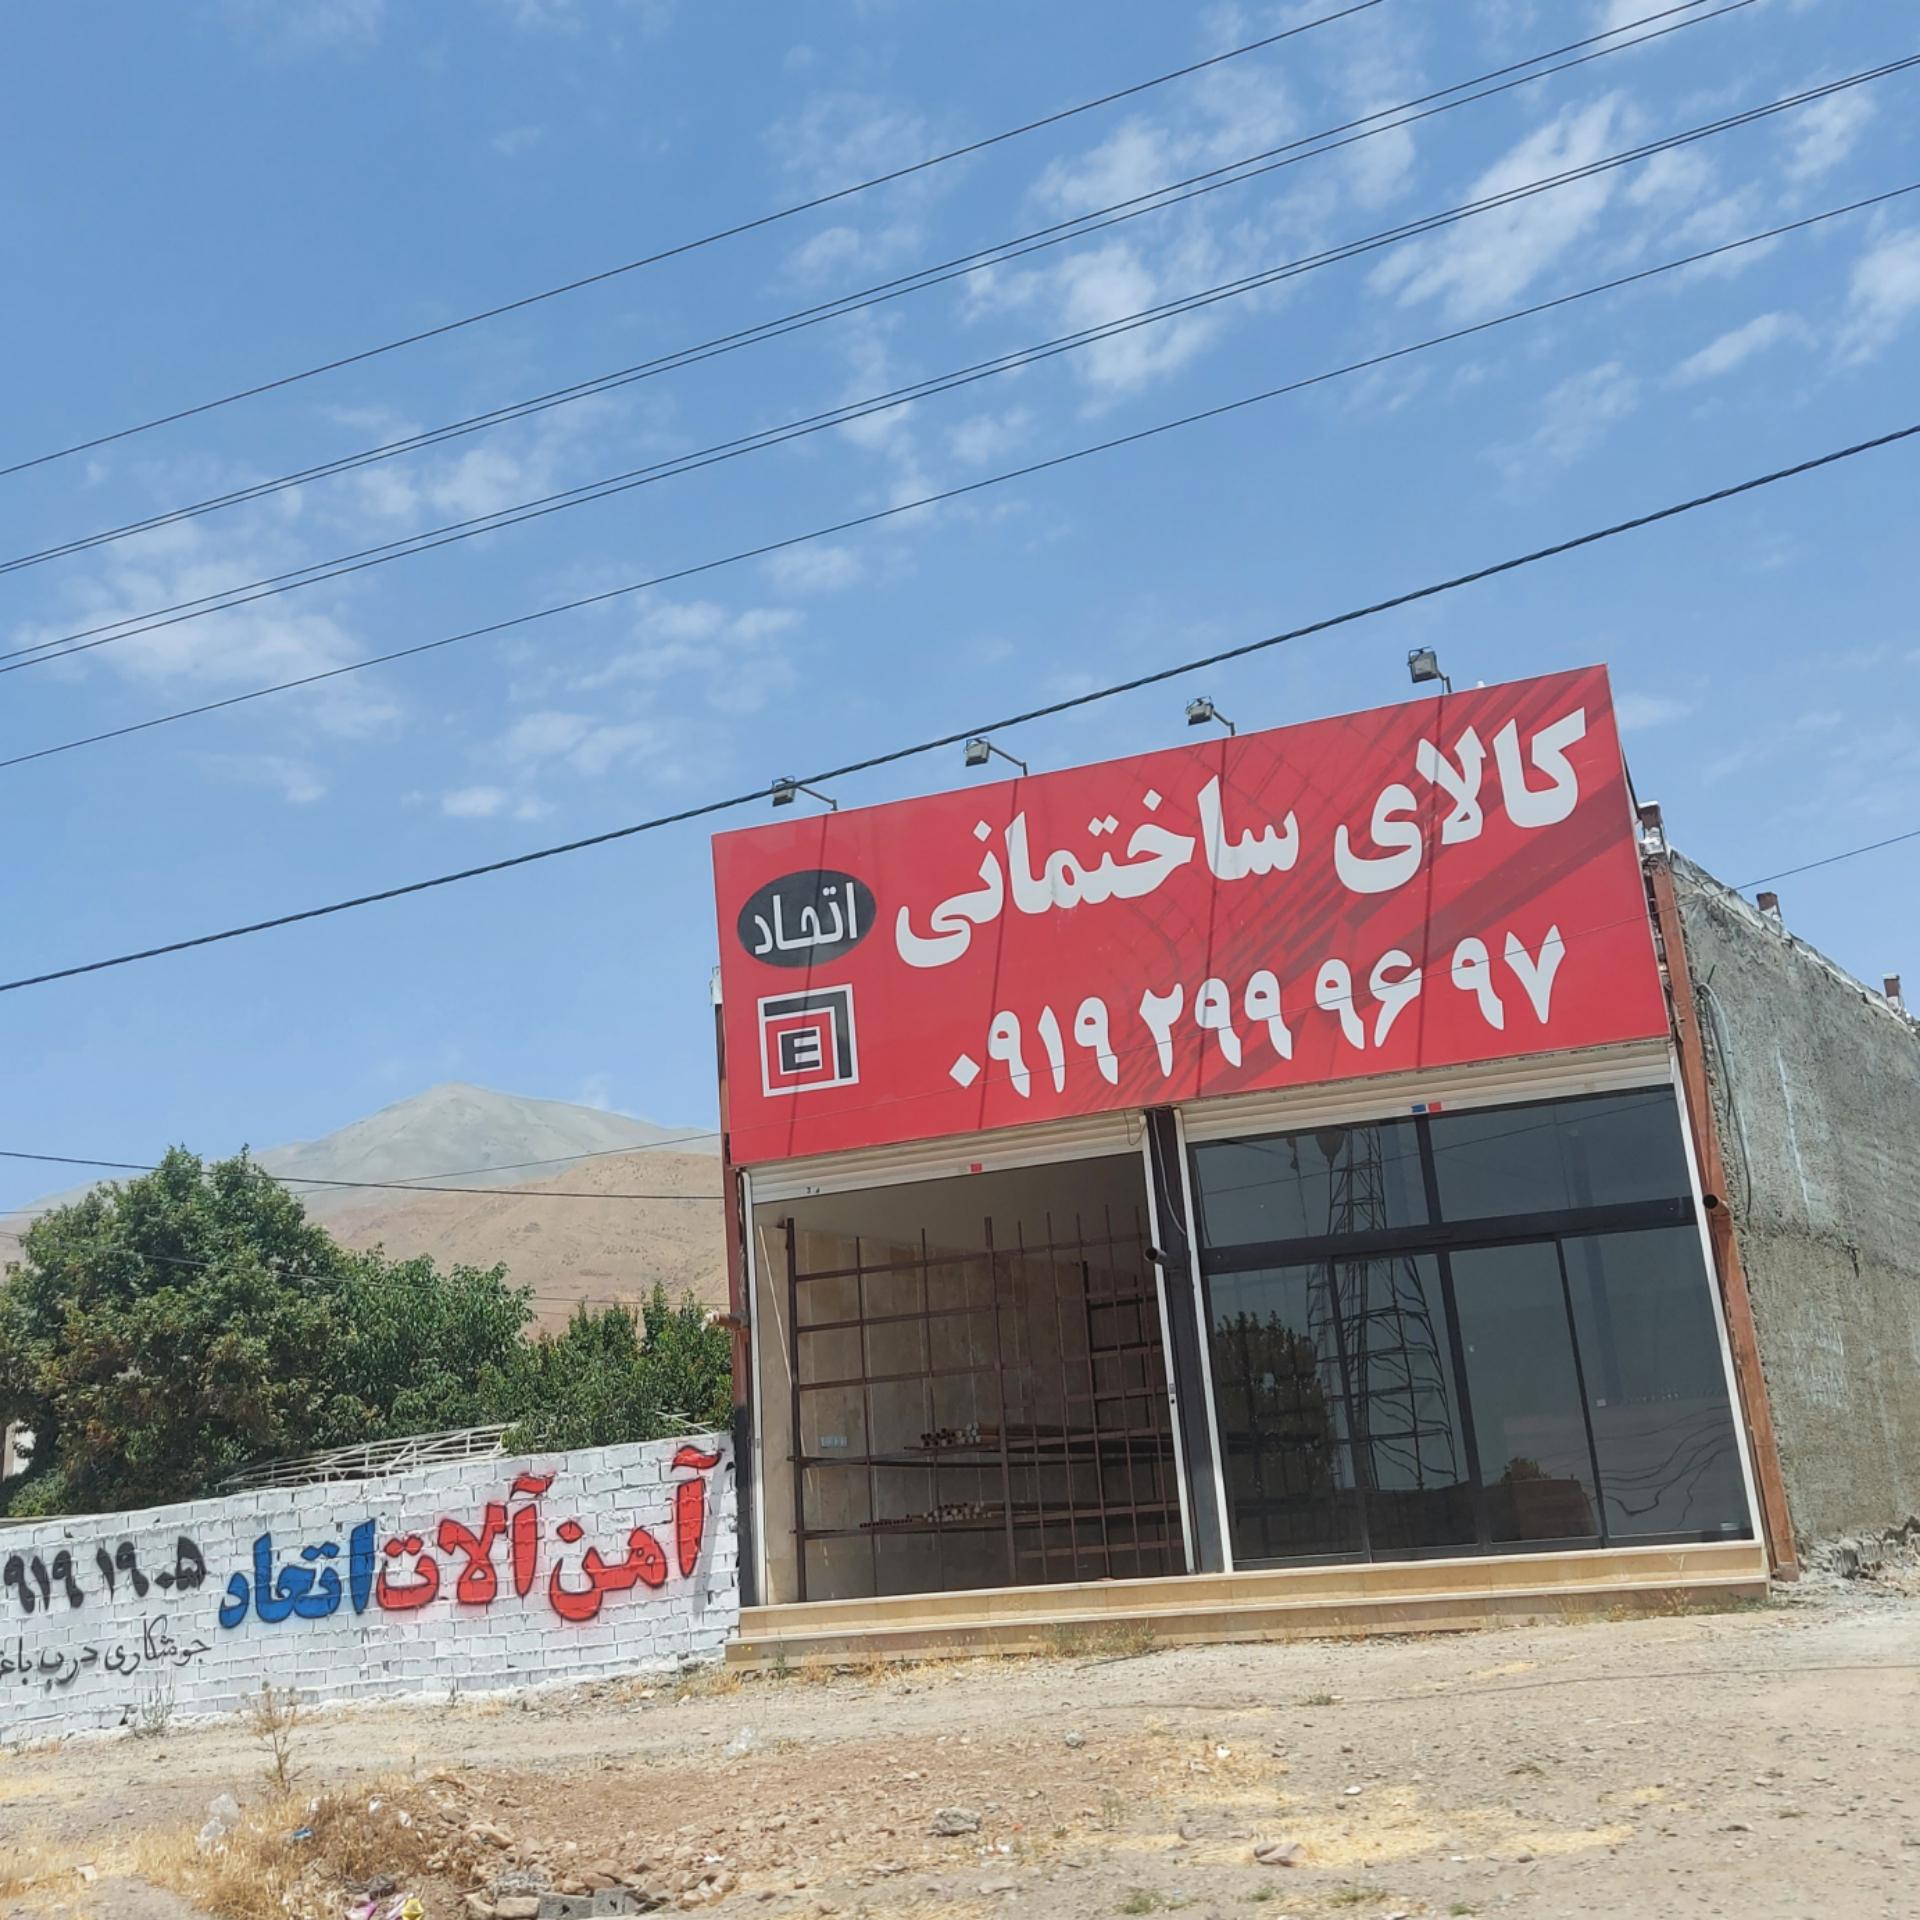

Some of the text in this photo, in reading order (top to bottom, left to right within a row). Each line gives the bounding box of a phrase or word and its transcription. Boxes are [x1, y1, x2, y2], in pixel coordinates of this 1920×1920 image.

[754, 882, 858, 955] اتحاد
[895, 706, 1587, 969] کالای ساختمانی
[218, 1444, 724, 1629] آهن آلات اتحاد
